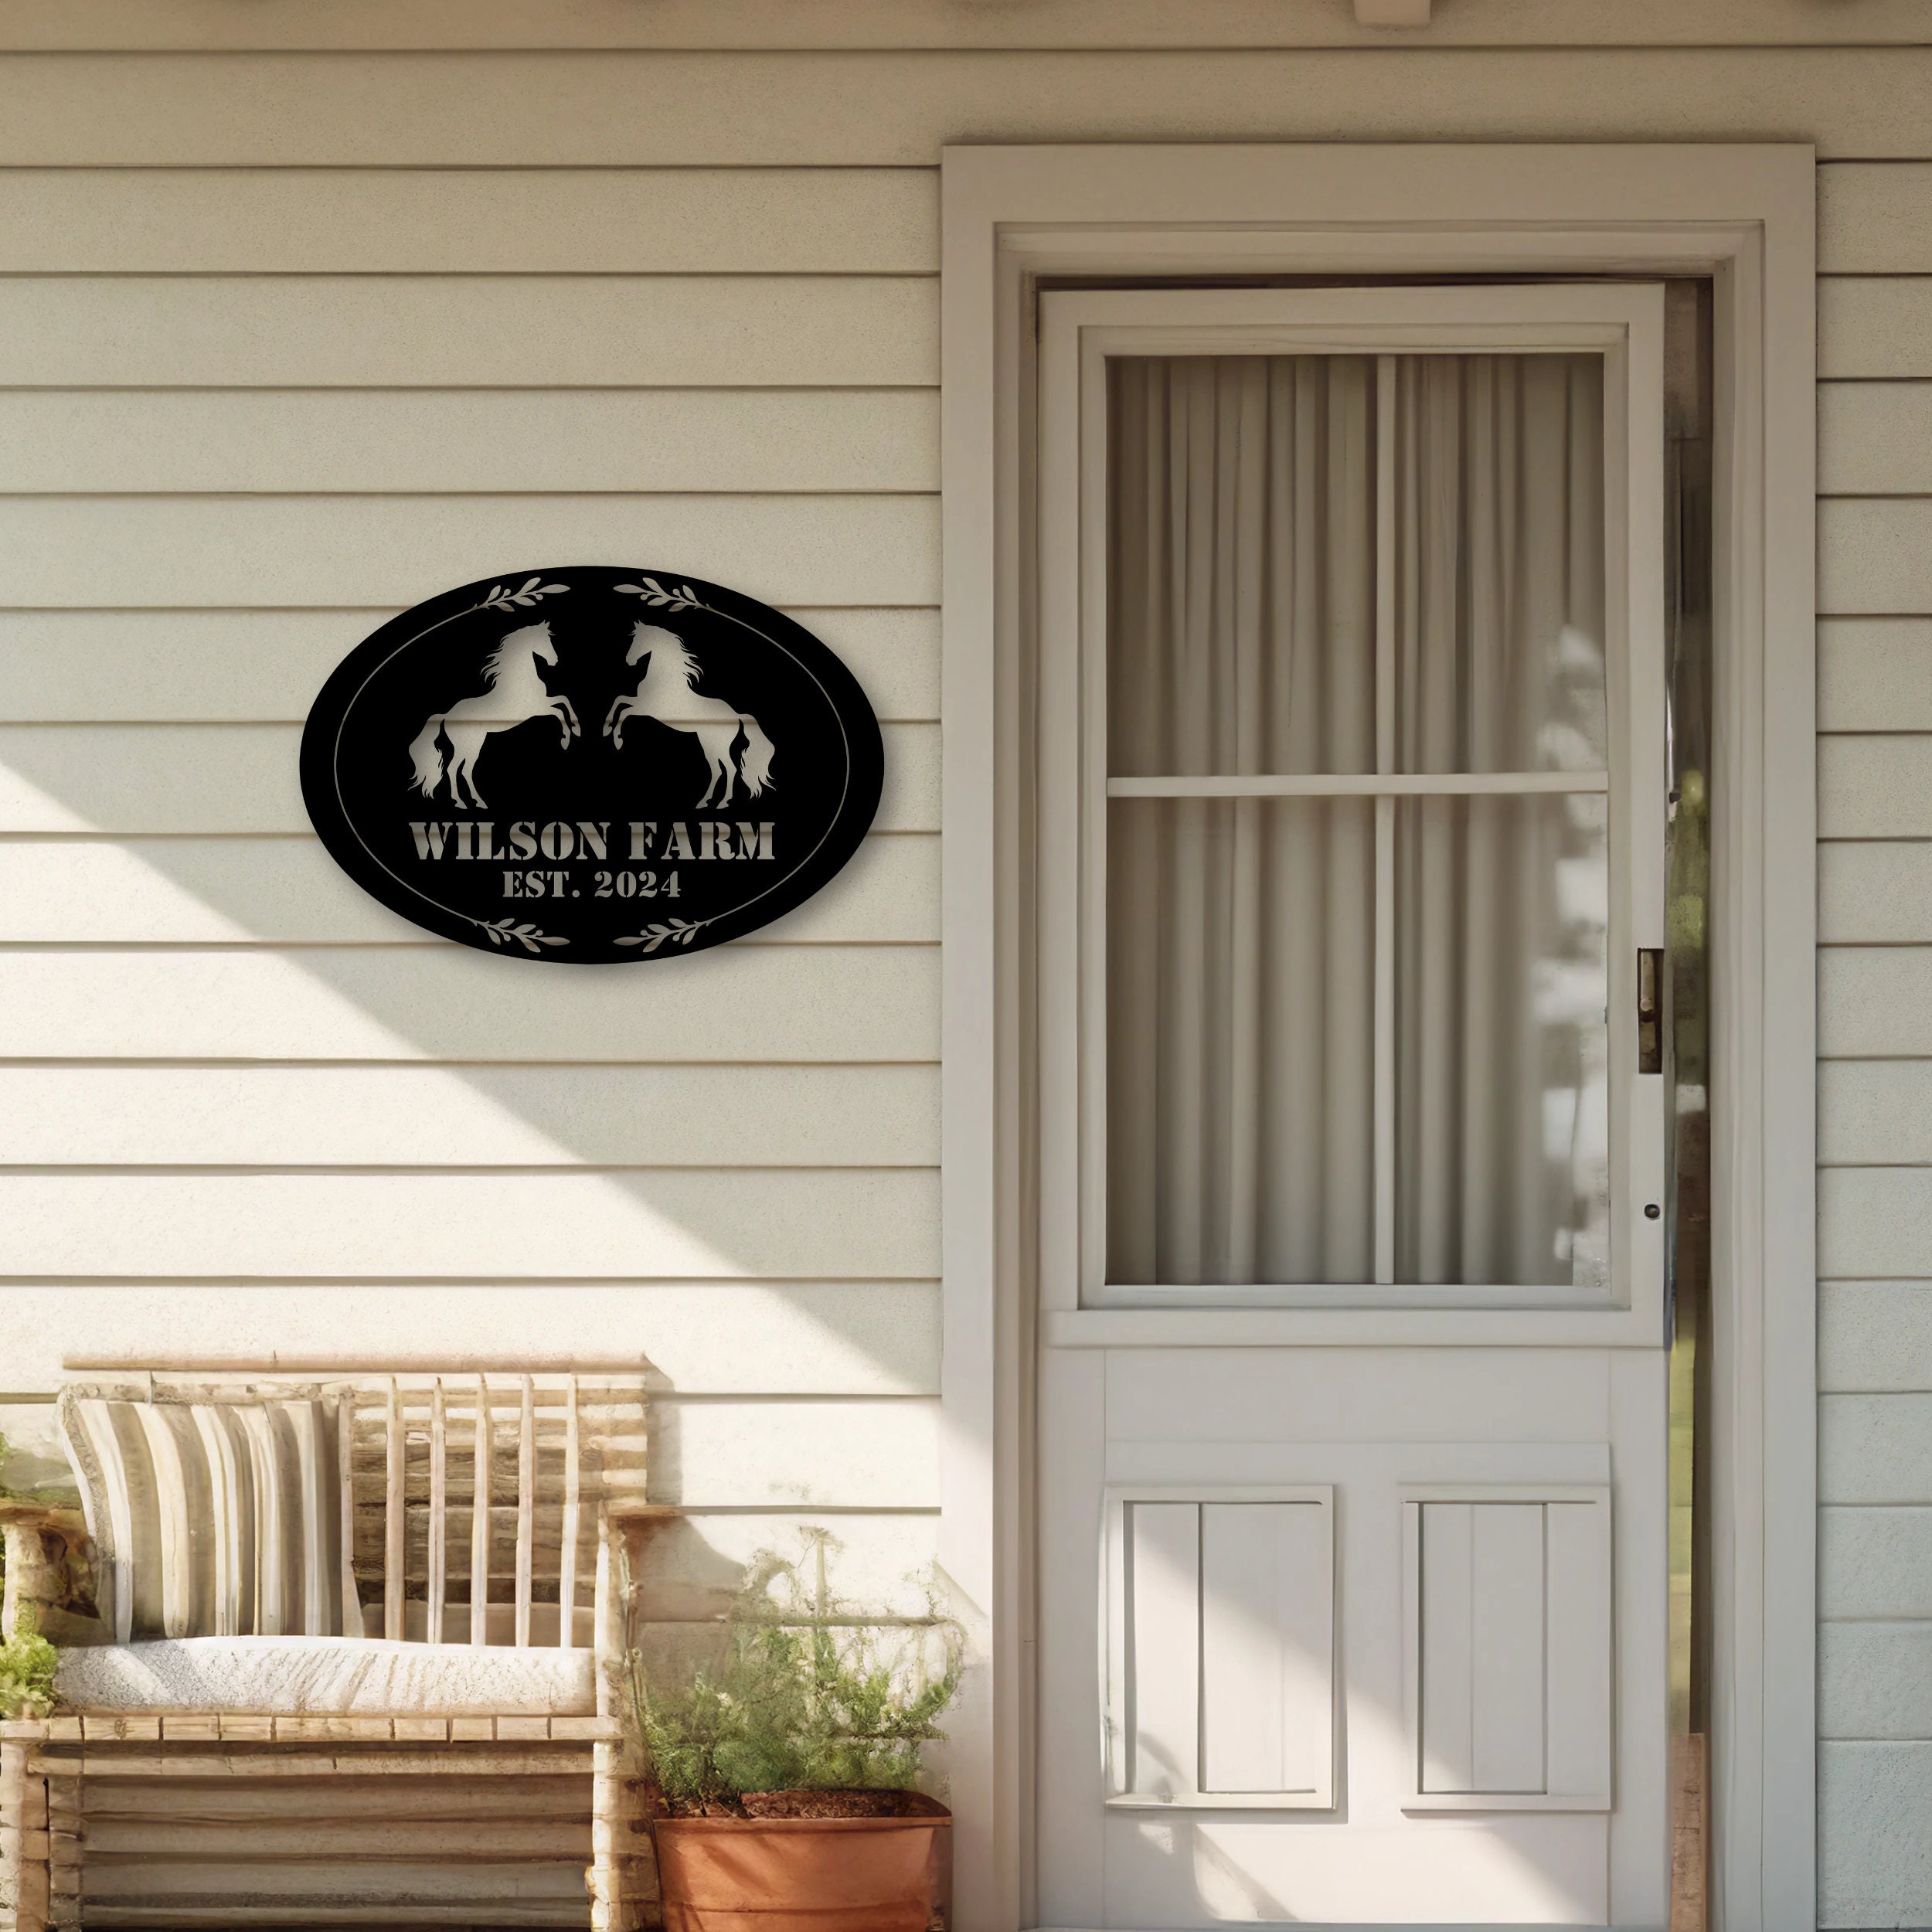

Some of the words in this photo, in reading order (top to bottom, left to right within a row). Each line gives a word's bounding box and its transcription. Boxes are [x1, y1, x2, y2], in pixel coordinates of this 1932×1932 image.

[408, 821, 611, 860] WILSON
[628, 821, 775, 860] FARM
[502, 871, 580, 897] EST.
[594, 871, 681, 897] 2024
